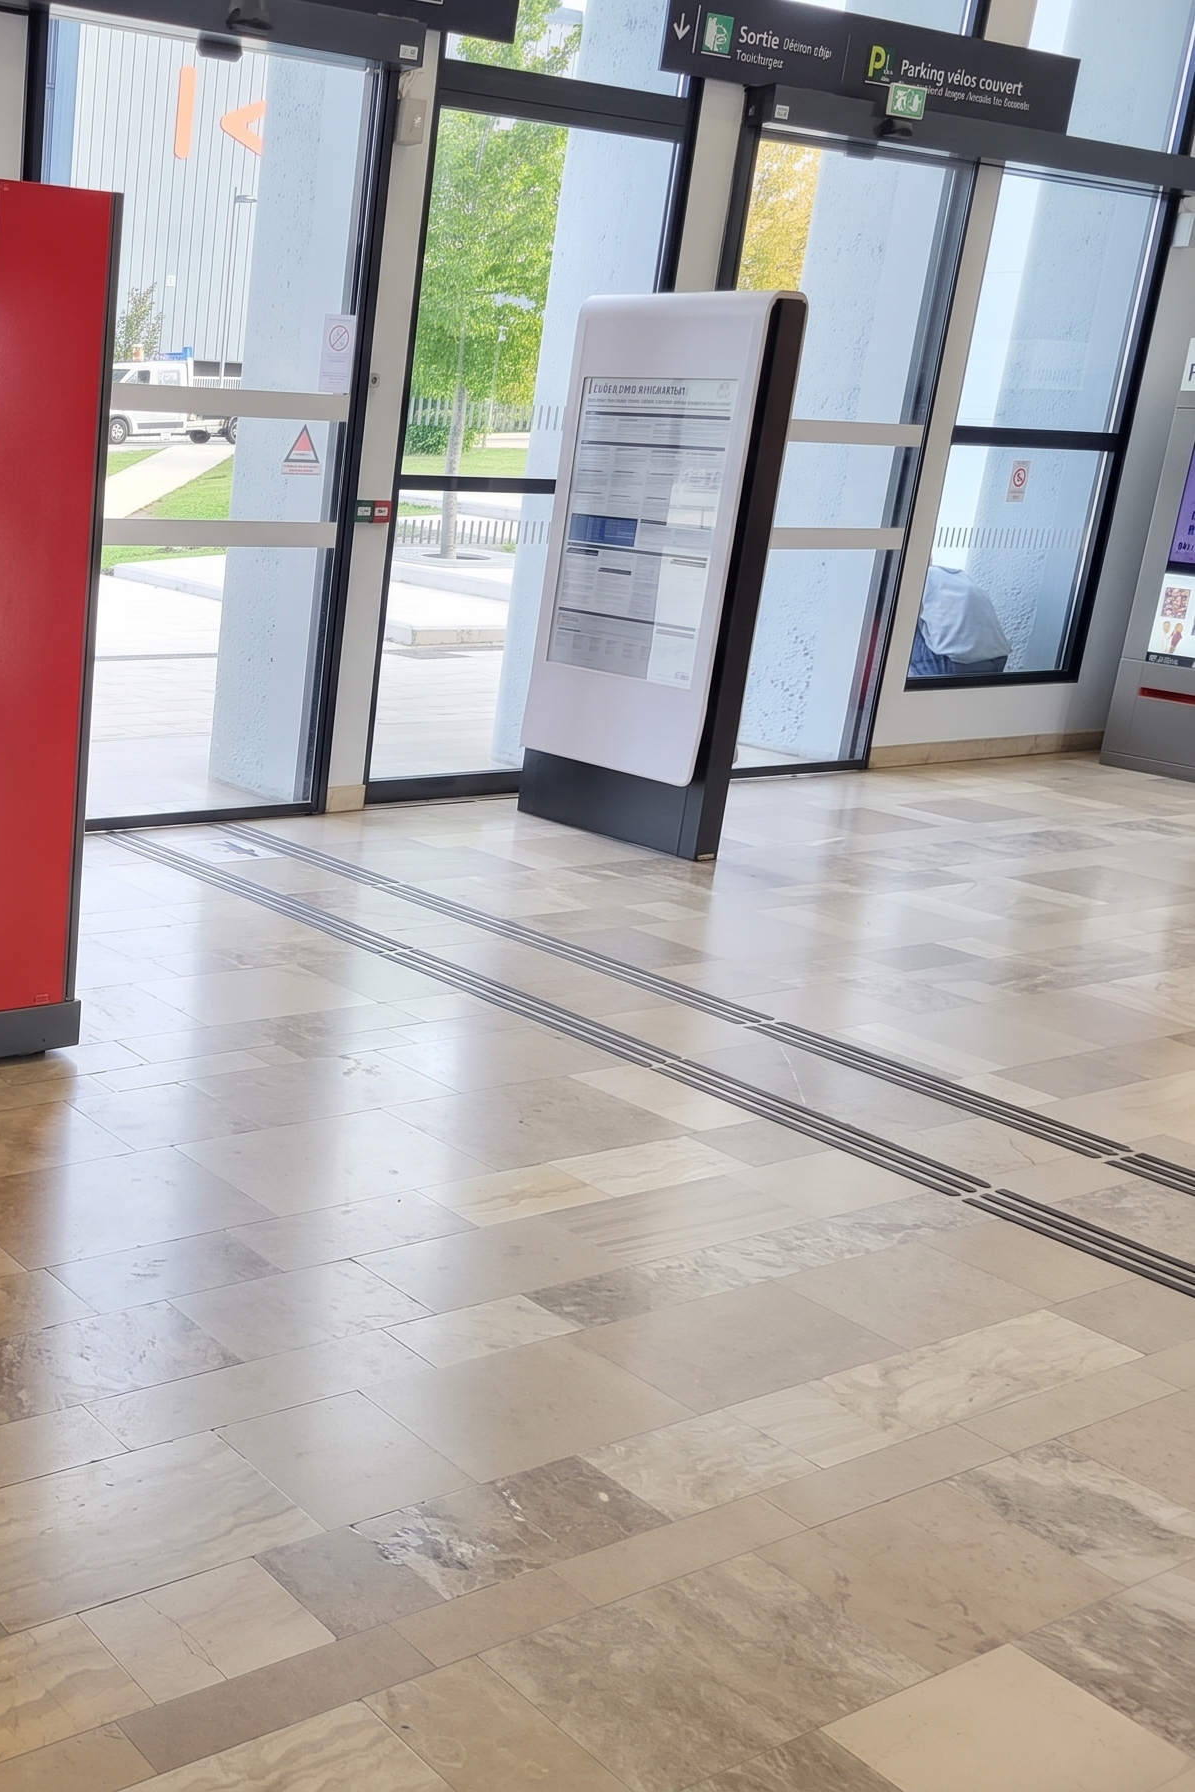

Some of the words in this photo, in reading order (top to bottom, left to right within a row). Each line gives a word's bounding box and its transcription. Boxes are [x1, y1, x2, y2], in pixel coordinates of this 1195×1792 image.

[739, 26, 780, 49] Sortie
[900, 59, 945, 87] Parking
[947, 69, 978, 89] vélos
[979, 77, 1024, 96] couvert
